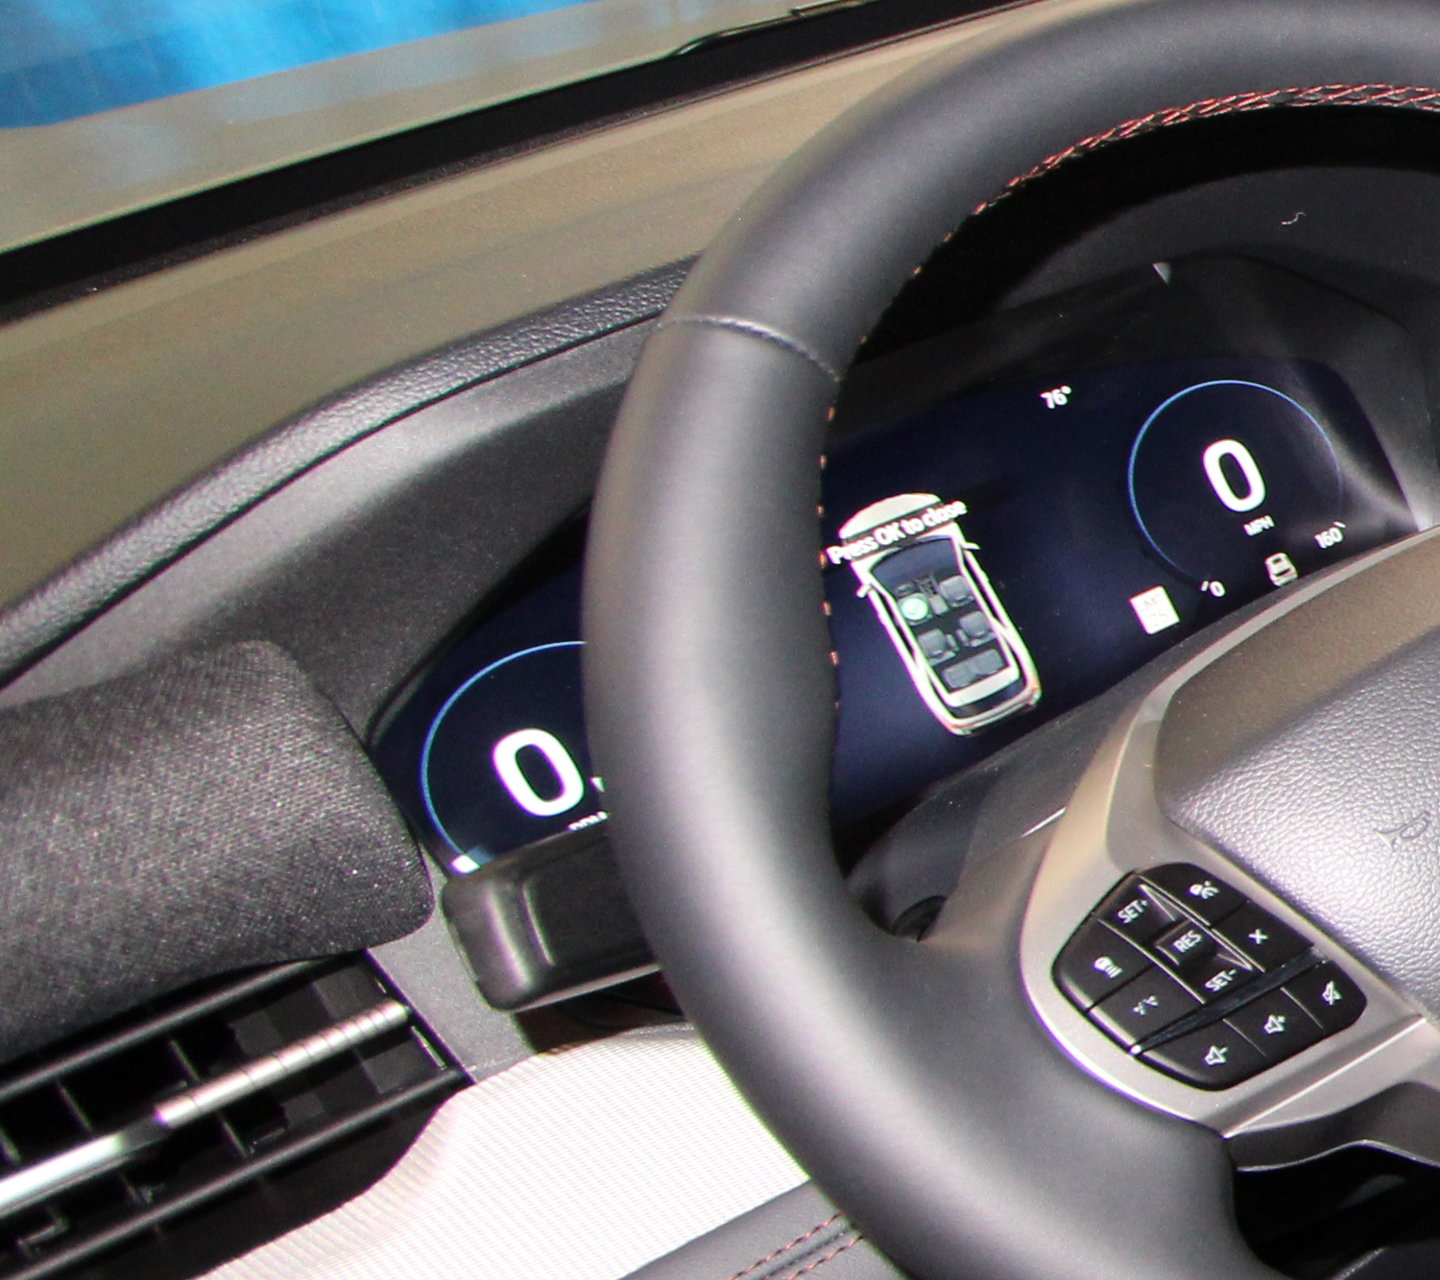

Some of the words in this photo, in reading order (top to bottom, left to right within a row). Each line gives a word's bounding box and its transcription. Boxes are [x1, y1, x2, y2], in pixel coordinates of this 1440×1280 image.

[1203, 438, 1266, 513] 0
[826, 537, 880, 565] Press
[872, 521, 902, 547] OK
[900, 516, 925, 536] to
[922, 500, 968, 526] close
[1243, 515, 1275, 536] MPH
[1314, 526, 1344, 549] 160
[491, 728, 585, 817] 0
[1117, 898, 1149, 924] SET+
[1173, 929, 1202, 954] RES
